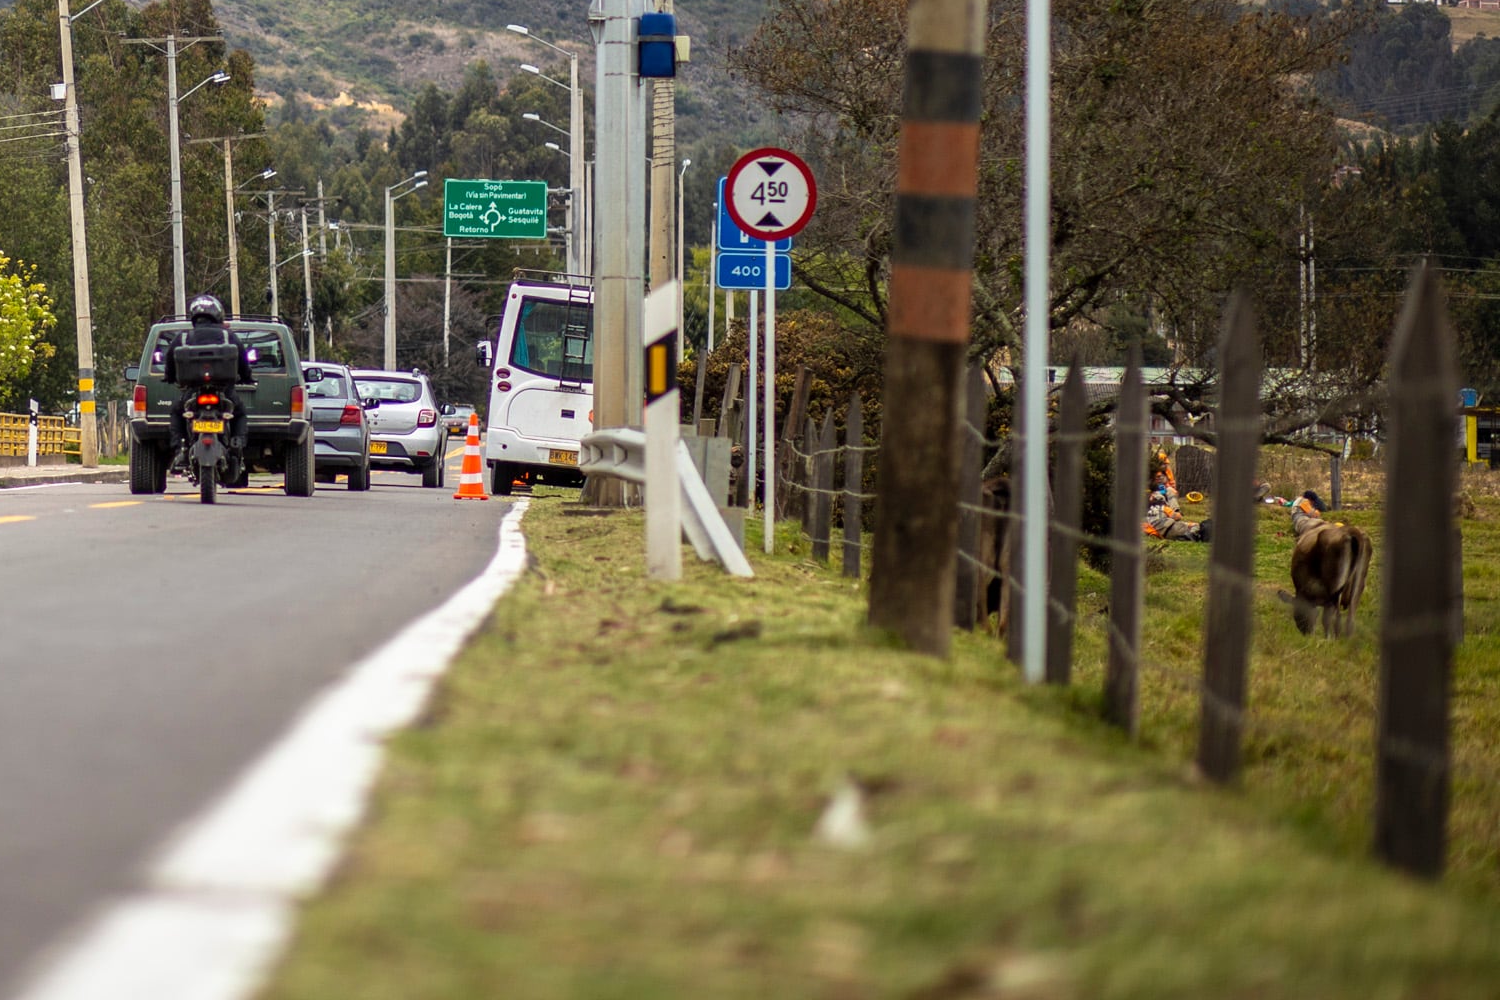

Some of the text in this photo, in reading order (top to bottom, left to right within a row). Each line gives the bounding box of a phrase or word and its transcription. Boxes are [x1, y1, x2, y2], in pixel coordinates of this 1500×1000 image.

[483, 183, 503, 192] Sopó
[479, 191, 489, 199] sin
[449, 202, 483, 211] La Calera
[448, 211, 474, 221] Bogotá
[508, 207, 544, 216] Guatavita
[508, 215, 540, 225] Sesquilé
[459, 225, 489, 233] Retorno
[731, 265, 761, 277] 400
